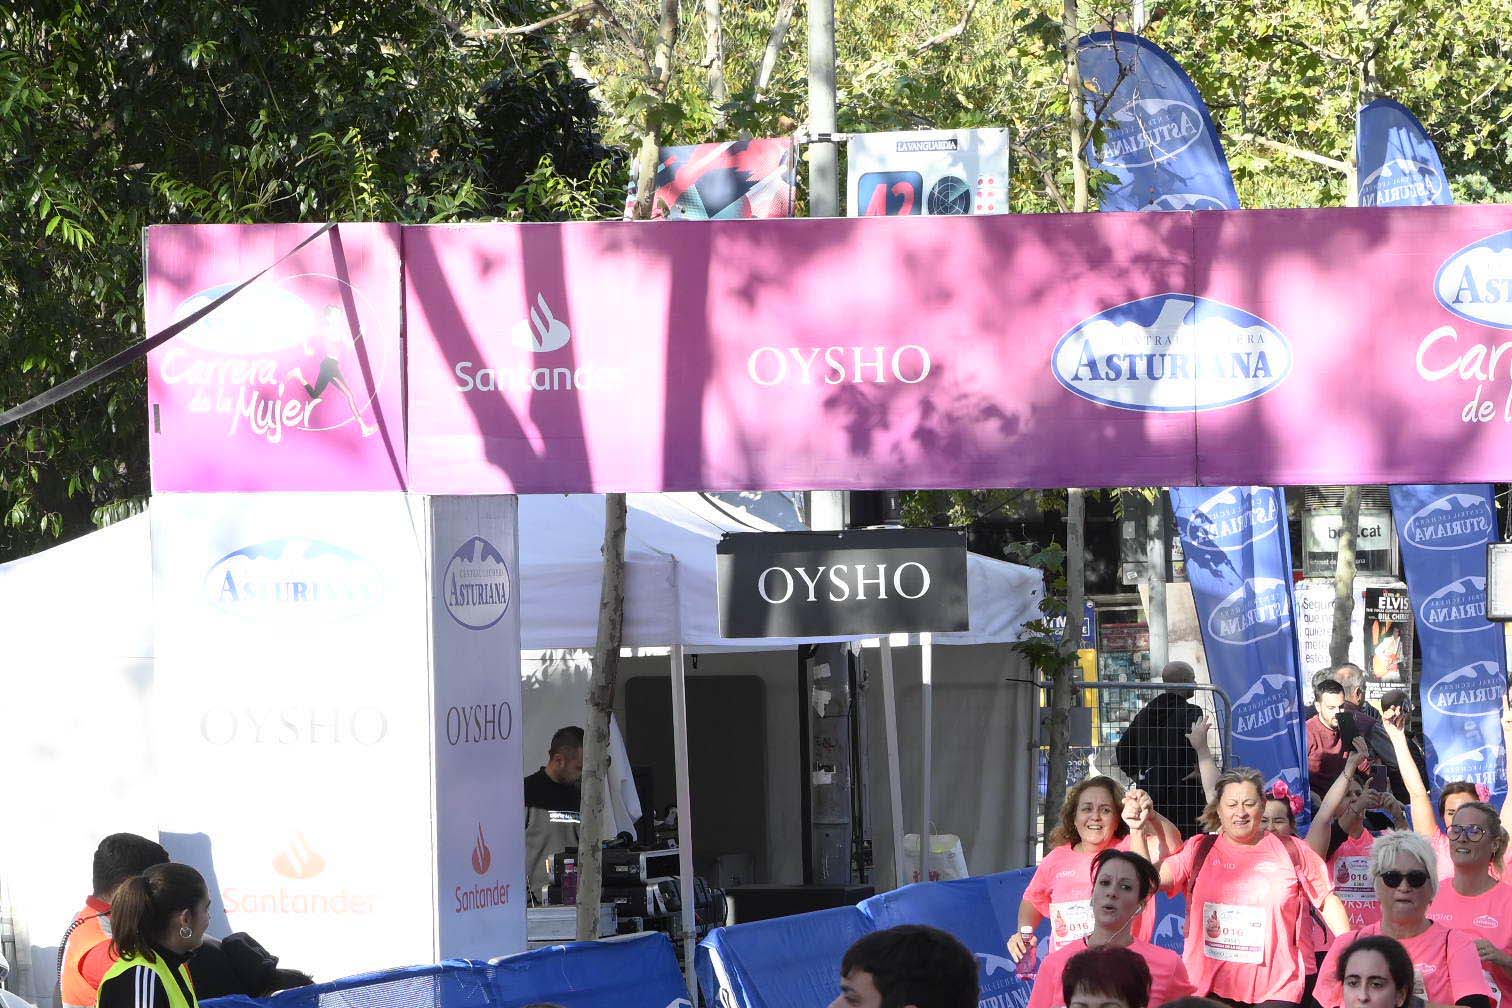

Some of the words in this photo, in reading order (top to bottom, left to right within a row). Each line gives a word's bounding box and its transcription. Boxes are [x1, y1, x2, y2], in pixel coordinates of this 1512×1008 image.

[747, 345, 931, 386] OYSHO
[1071, 339, 1273, 382] ASTURANA
[1462, 385, 1496, 424] de
[449, 571, 506, 606] ASTURIANA
[758, 562, 931, 604] OYSHO
[1378, 597, 1409, 609] ELVIS
[200, 705, 388, 746] OYSHO
[446, 701, 512, 746] OYSHO
[223, 887, 379, 914] Santander
[456, 882, 511, 914] Santander
[1069, 922, 1088, 932] 016
